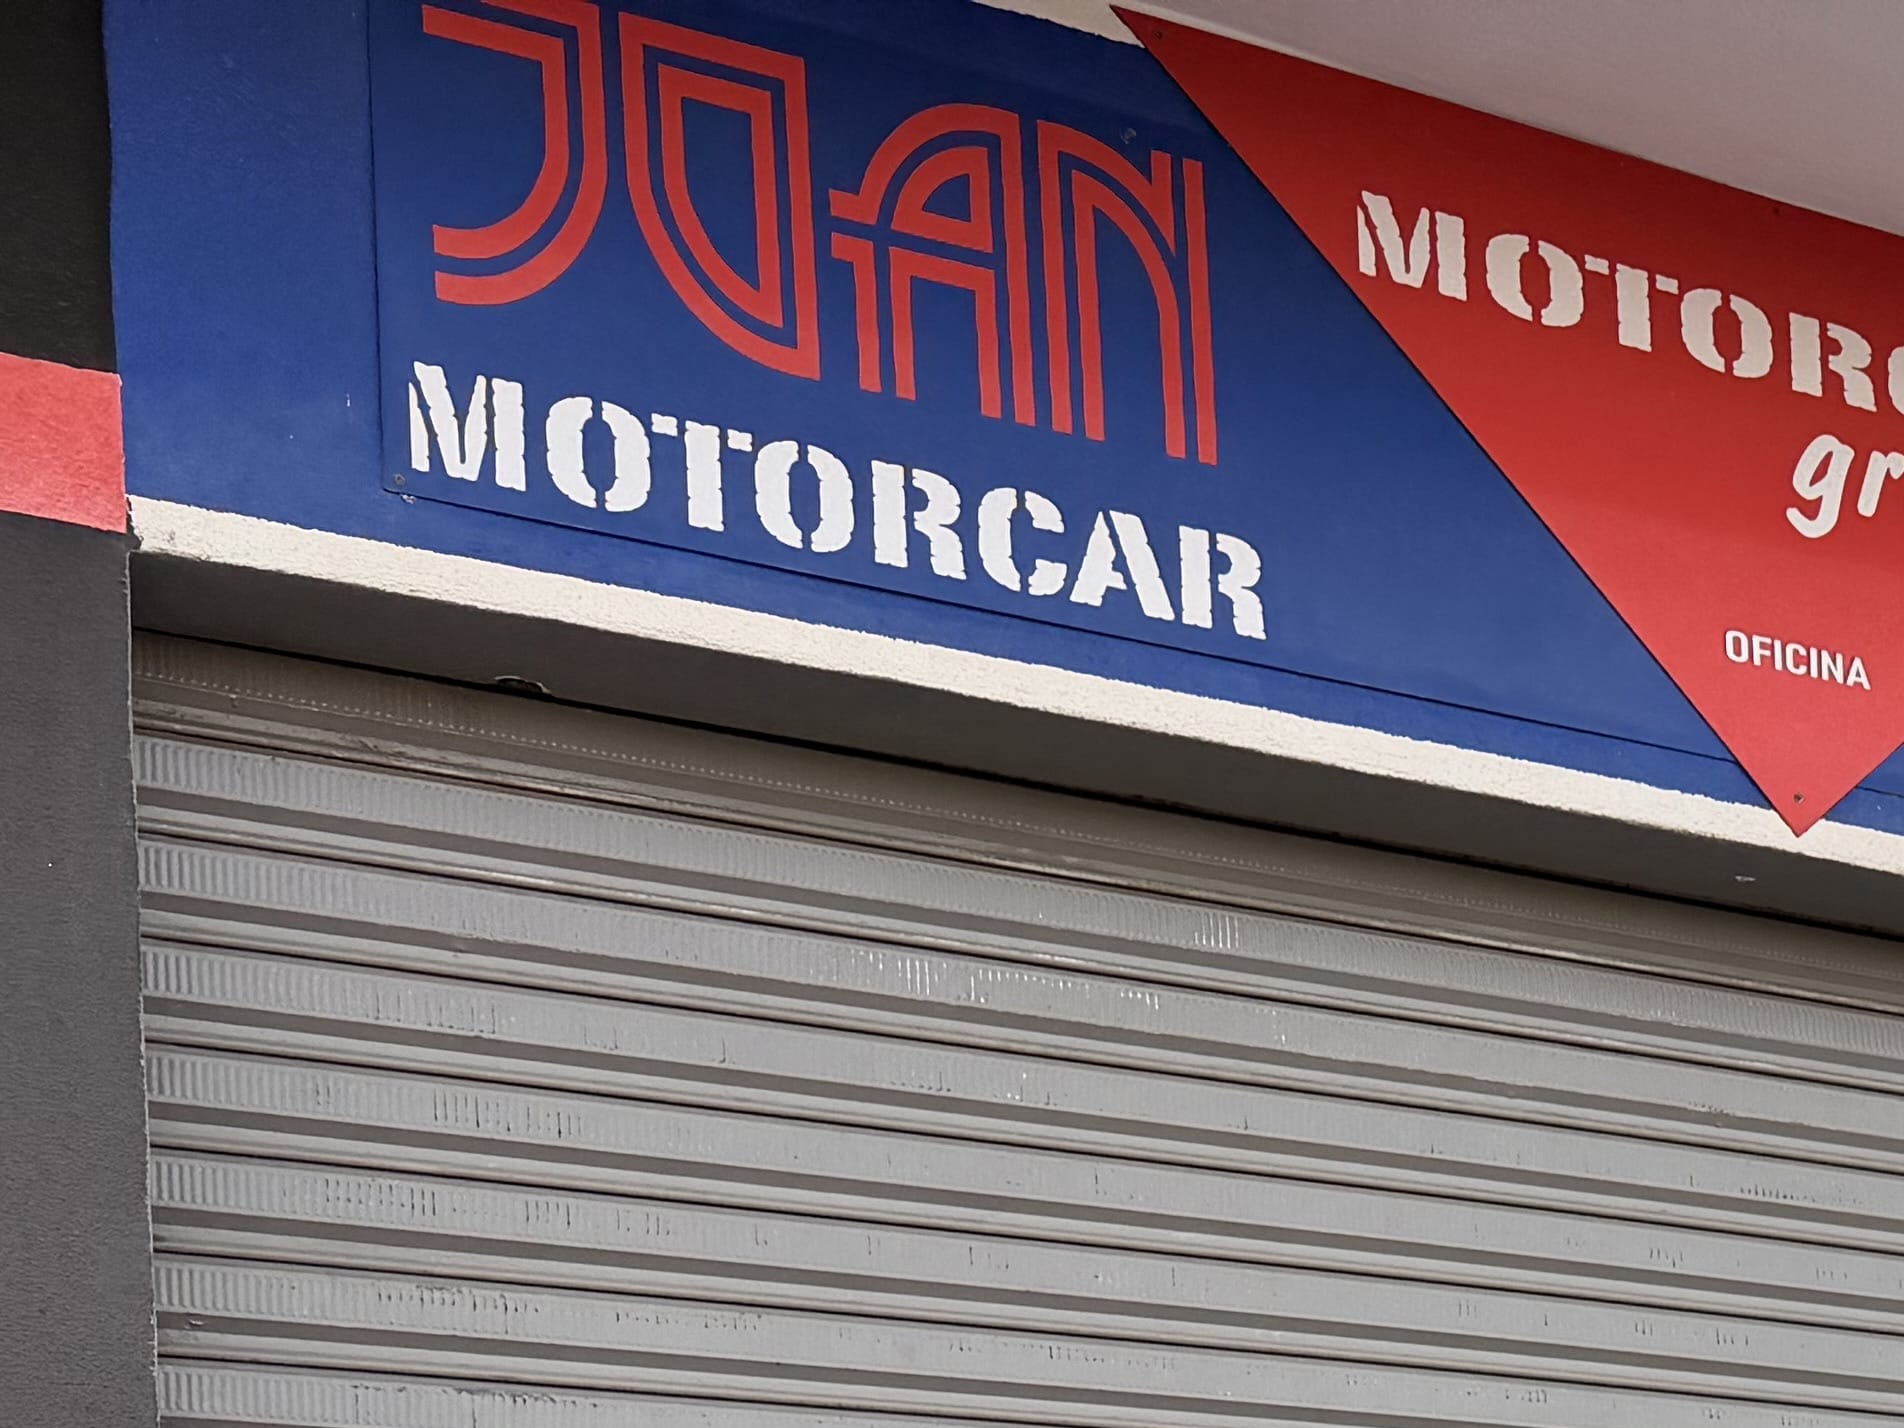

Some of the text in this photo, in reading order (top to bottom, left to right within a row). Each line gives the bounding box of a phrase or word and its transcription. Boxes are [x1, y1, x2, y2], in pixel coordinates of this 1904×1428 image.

[422, 0, 1217, 466] JUAN
[408, 361, 1268, 640] MOTORCAR
[1723, 629, 1872, 692] OFICINA
